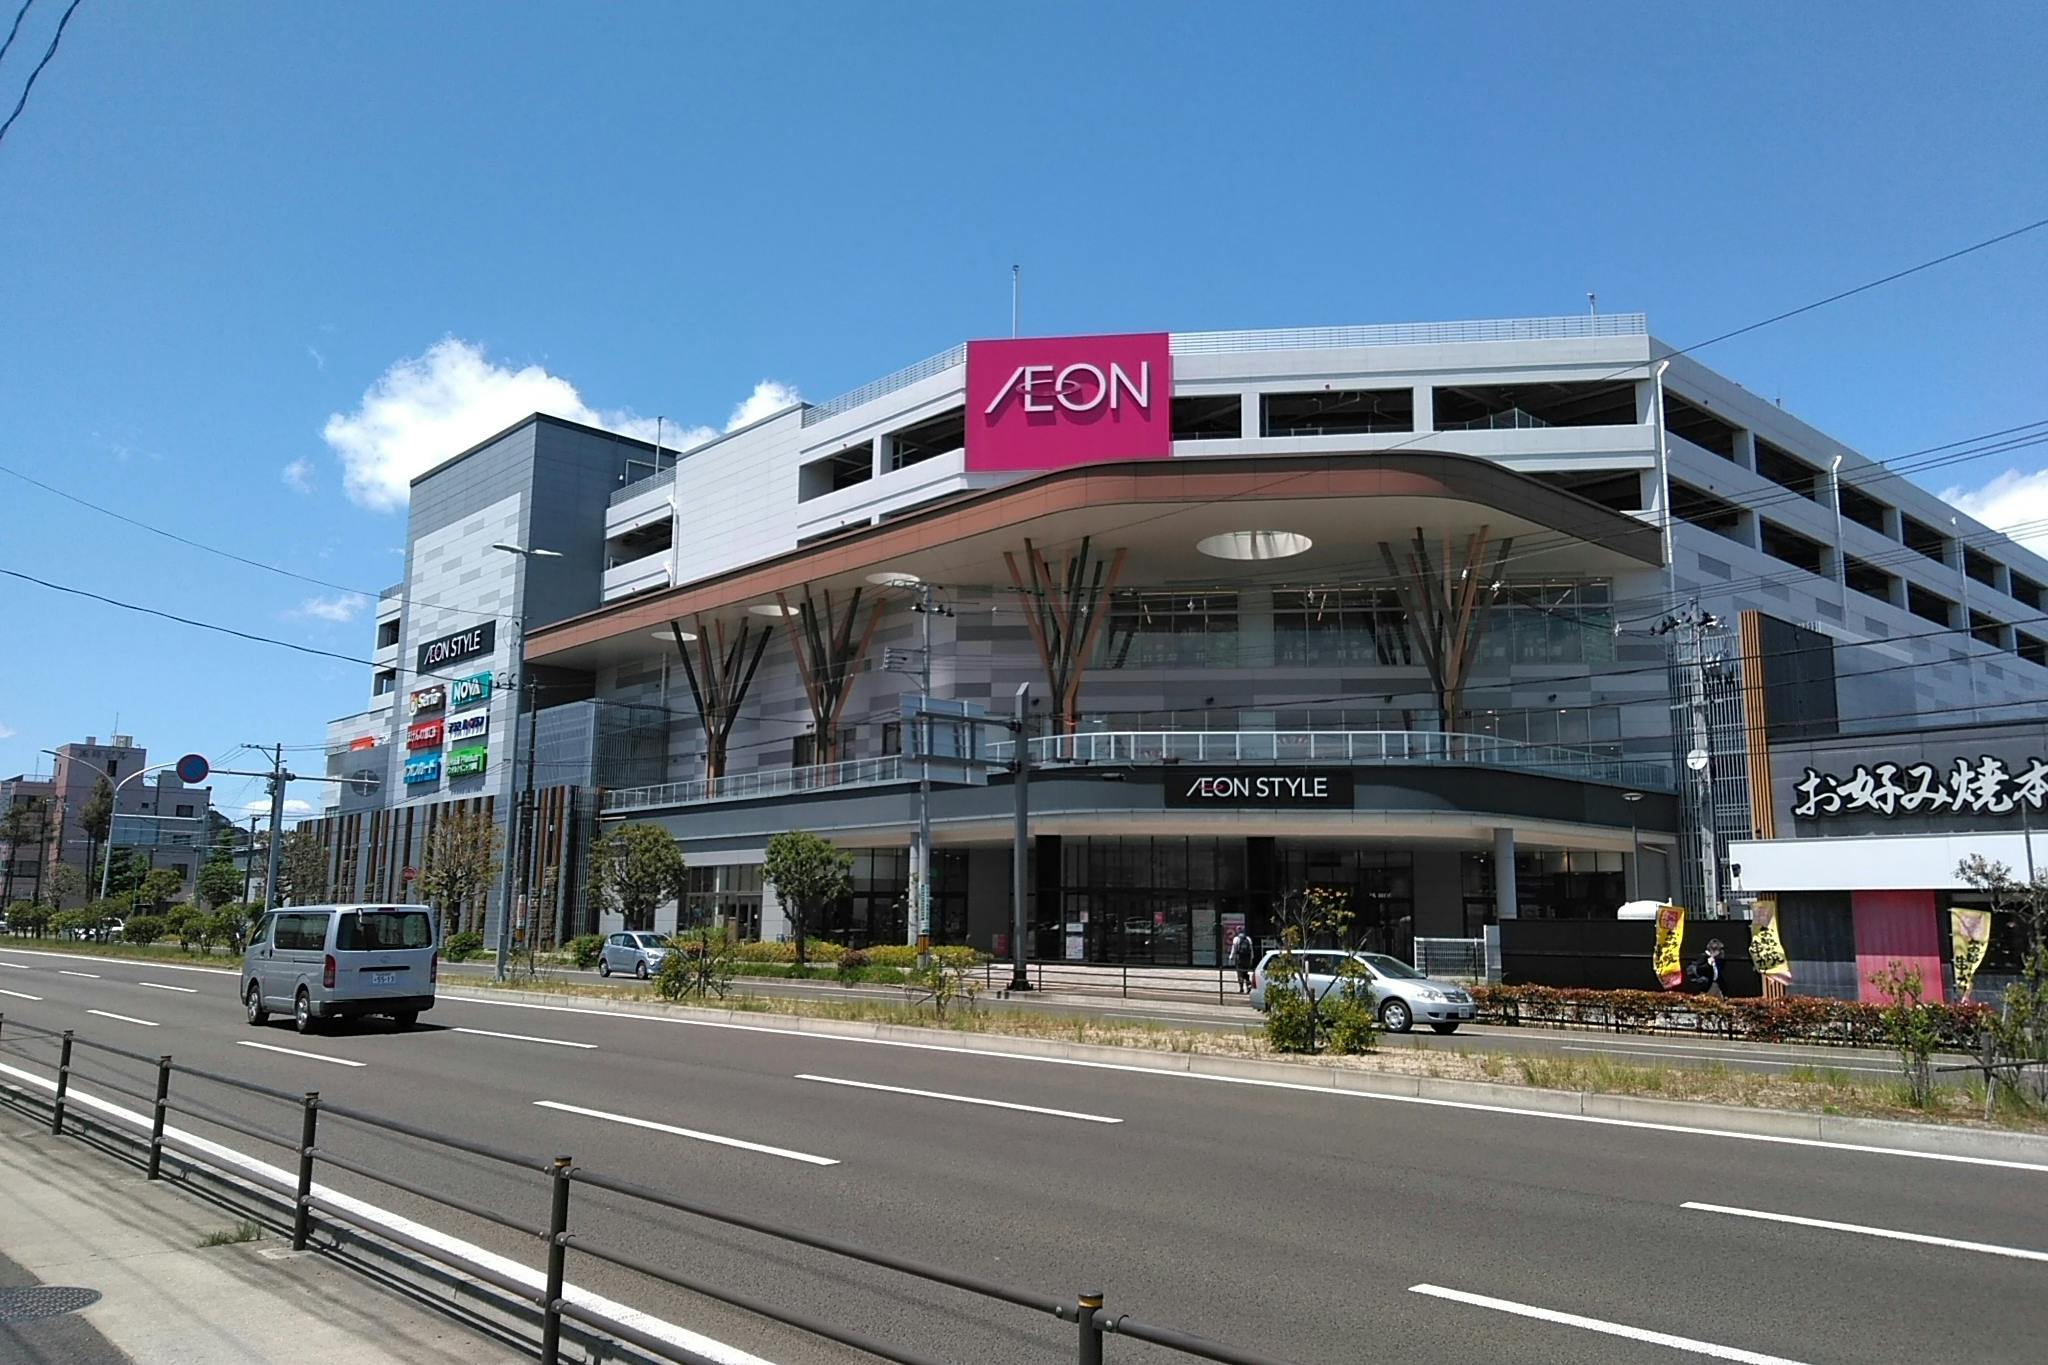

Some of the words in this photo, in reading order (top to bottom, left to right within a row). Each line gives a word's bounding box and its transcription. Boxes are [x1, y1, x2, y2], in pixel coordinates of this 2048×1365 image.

[450, 630, 481, 657] STYLE
[417, 688, 441, 708] Seria
[454, 678, 480, 704] NOVA
[1256, 777, 1328, 797] STYLE
[1795, 756, 2048, 815] お好み焼本
